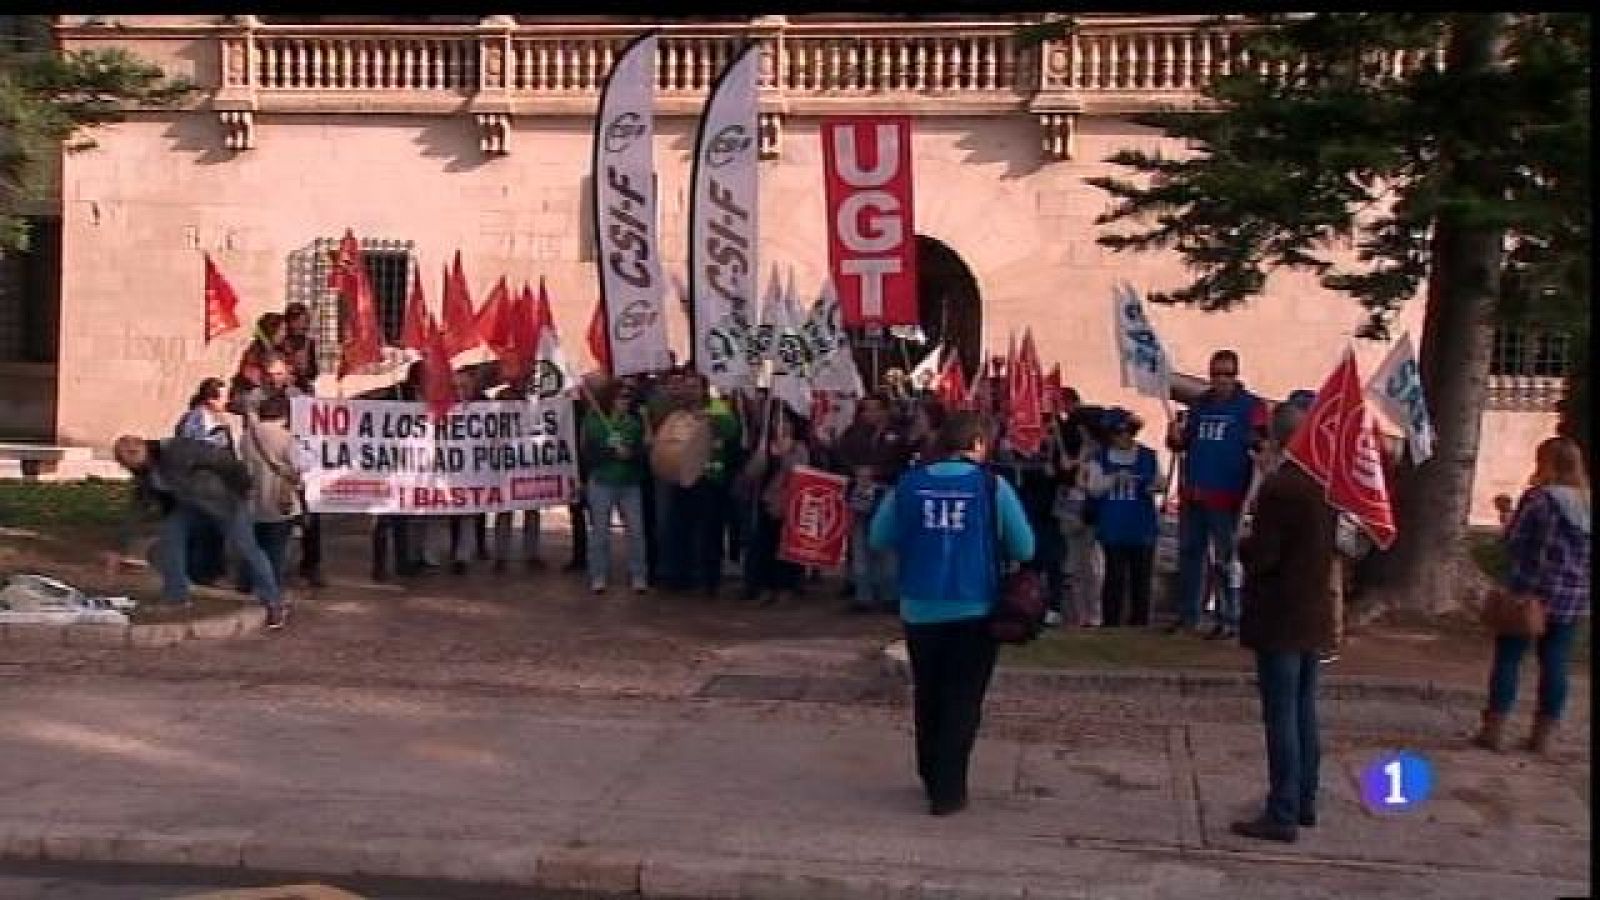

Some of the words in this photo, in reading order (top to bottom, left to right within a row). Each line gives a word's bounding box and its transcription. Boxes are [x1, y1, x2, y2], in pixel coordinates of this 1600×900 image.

[834, 124, 904, 316] UGT
[310, 404, 350, 436] NO
[359, 411, 374, 438] A
[383, 414, 427, 441] LOS
[322, 440, 350, 469] LA
[414, 486, 503, 508] BASTA
